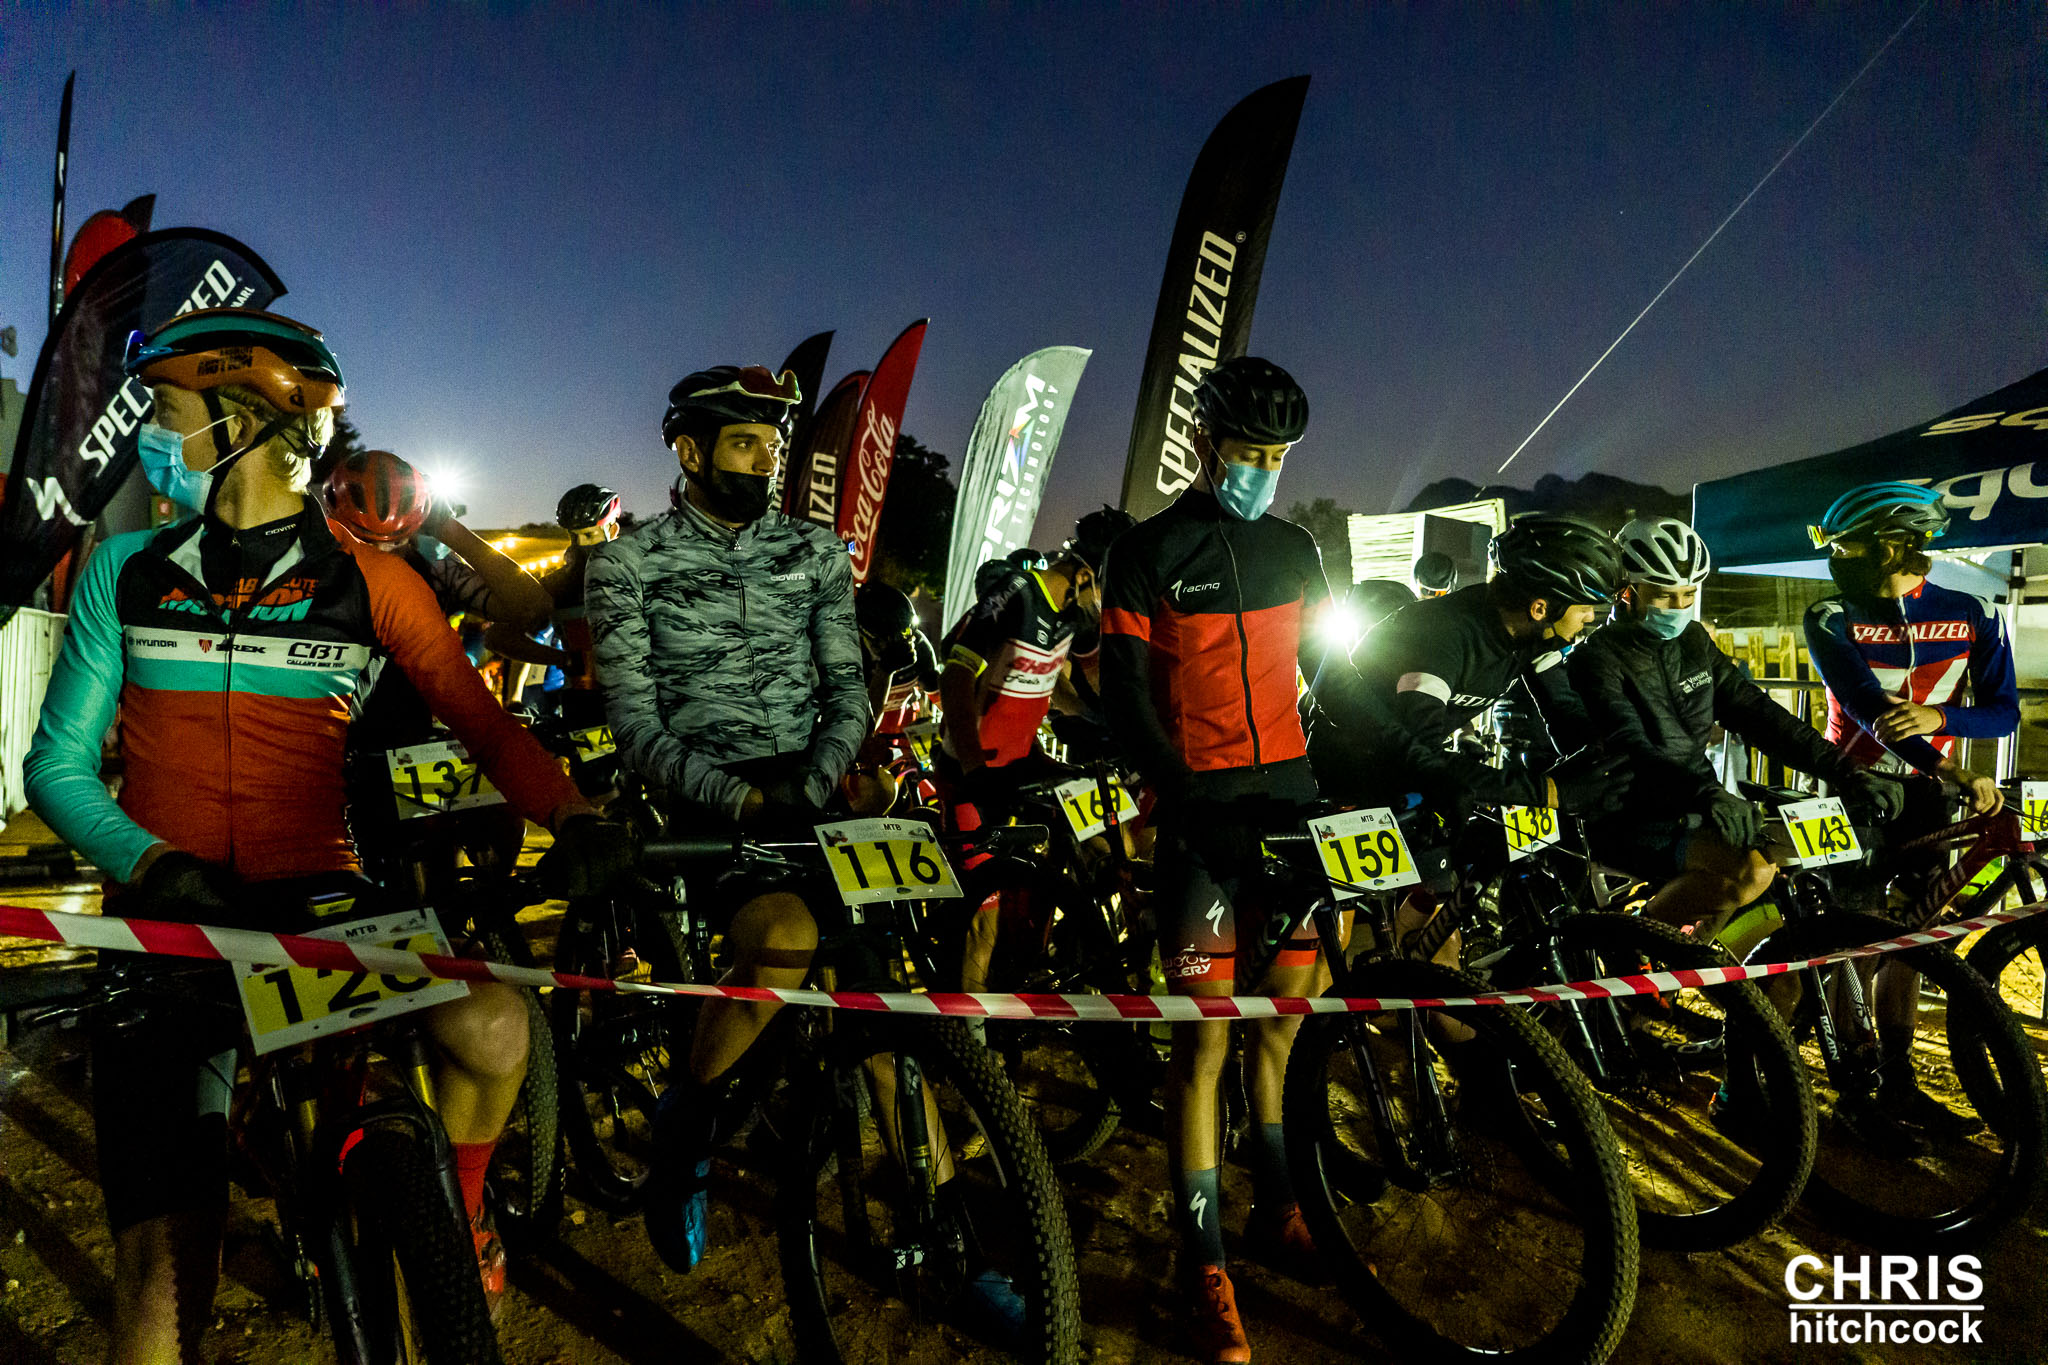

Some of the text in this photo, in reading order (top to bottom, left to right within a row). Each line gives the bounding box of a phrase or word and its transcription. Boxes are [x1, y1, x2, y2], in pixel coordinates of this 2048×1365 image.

[1183, 582, 1221, 593] racing
[136, 638, 178, 648] HYUNDAI
[287, 641, 350, 661] CBT
[883, 823, 902, 831] MTB
[1511, 806, 1552, 848] 138
[1795, 816, 1851, 856] 143
[839, 842, 941, 888] 116
[1329, 831, 1400, 883] 159
[345, 924, 378, 938] MTB
